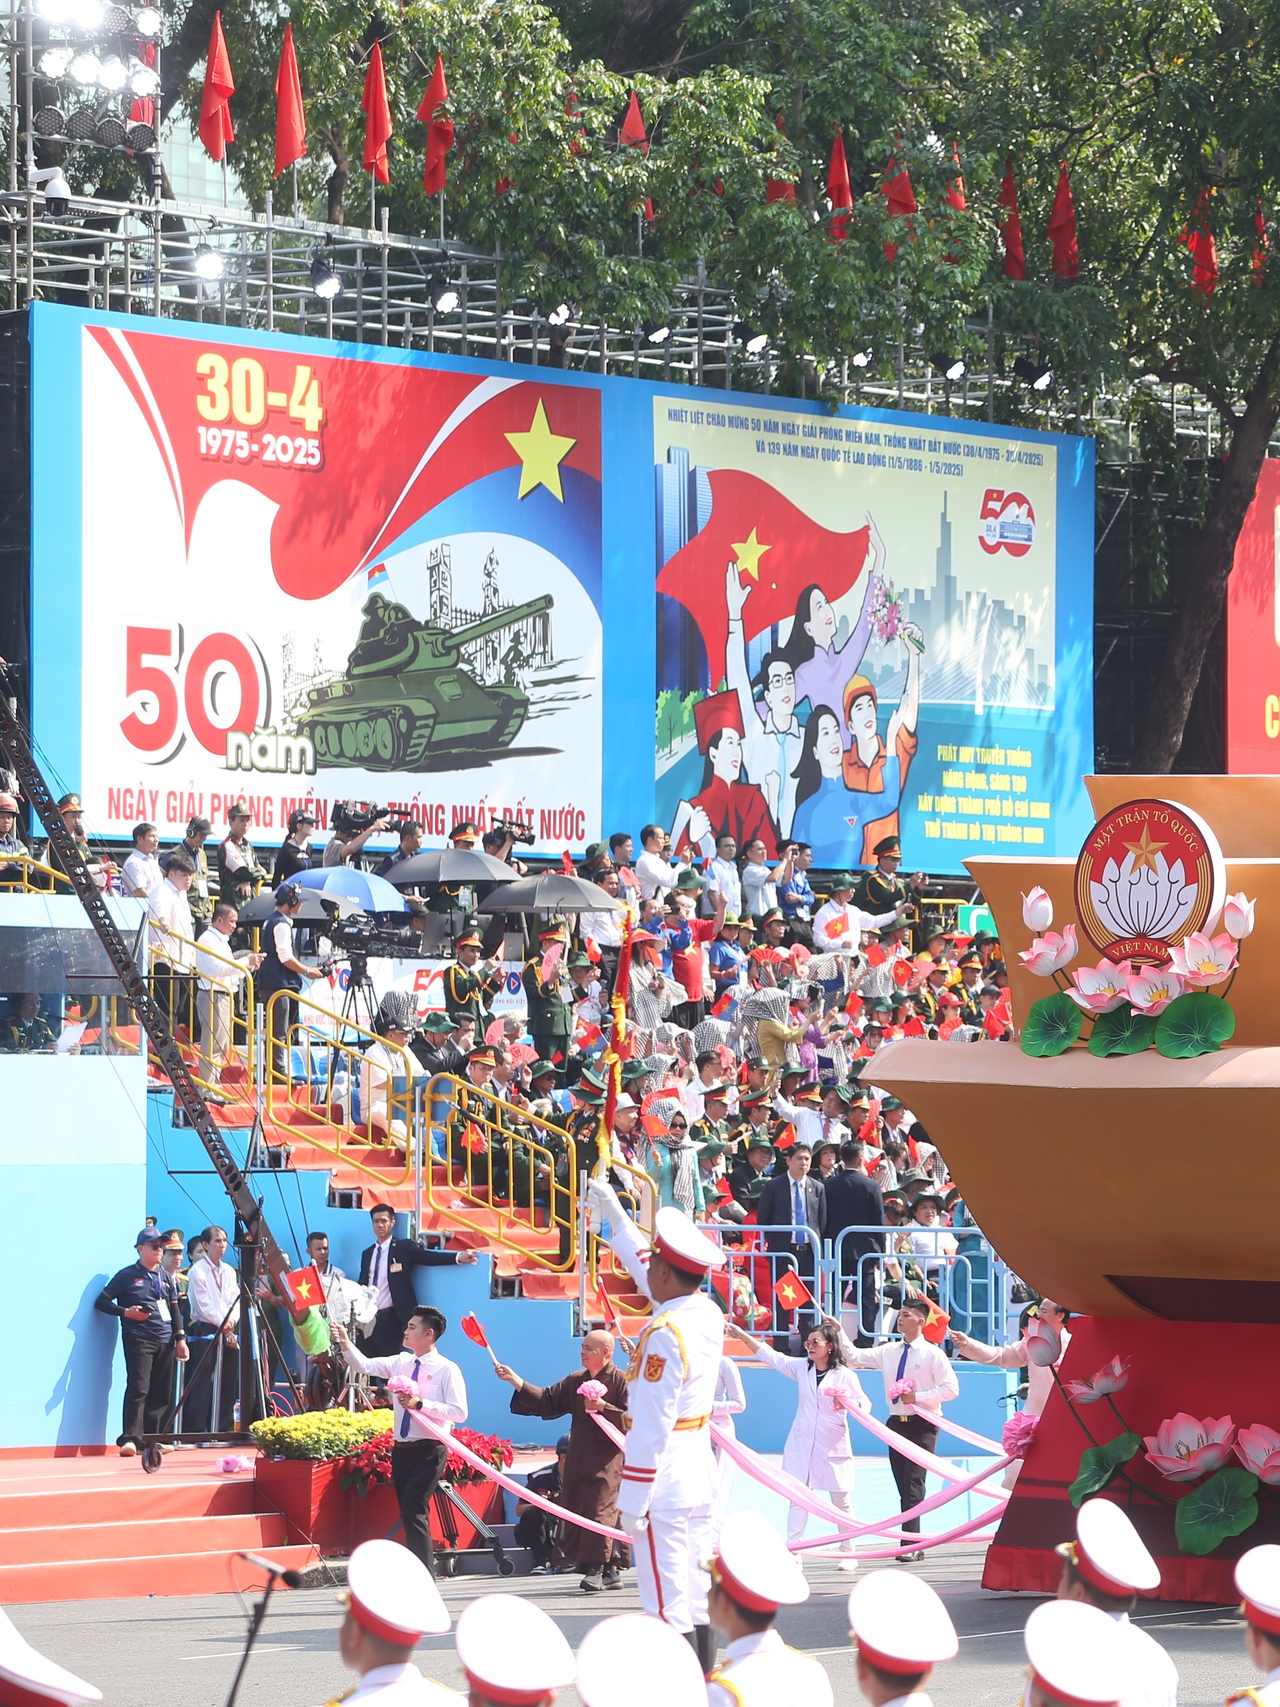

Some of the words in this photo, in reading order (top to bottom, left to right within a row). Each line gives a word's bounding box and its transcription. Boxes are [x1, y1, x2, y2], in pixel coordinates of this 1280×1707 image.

[196, 352, 323, 432] 30-4
[197, 425, 322, 466] 1975-2025
[751, 418, 761, 432] 50
[767, 442, 781, 455] 139
[853, 452, 865, 465] LAO
[119, 625, 260, 756] 50
[226, 725, 316, 775] năm
[107, 781, 159, 822] NGÀY
[166, 780, 203, 824] GIẢI
[210, 787, 273, 828] PHNG
[540, 803, 586, 841] NƯỚC
[1116, 808, 1150, 828] TRẬN
[1153, 809, 1171, 825] TỔ
[1170, 818, 1198, 853] QUỐC
[1112, 941, 1141, 957] VIỆT
[1143, 942, 1169, 959] NAM
